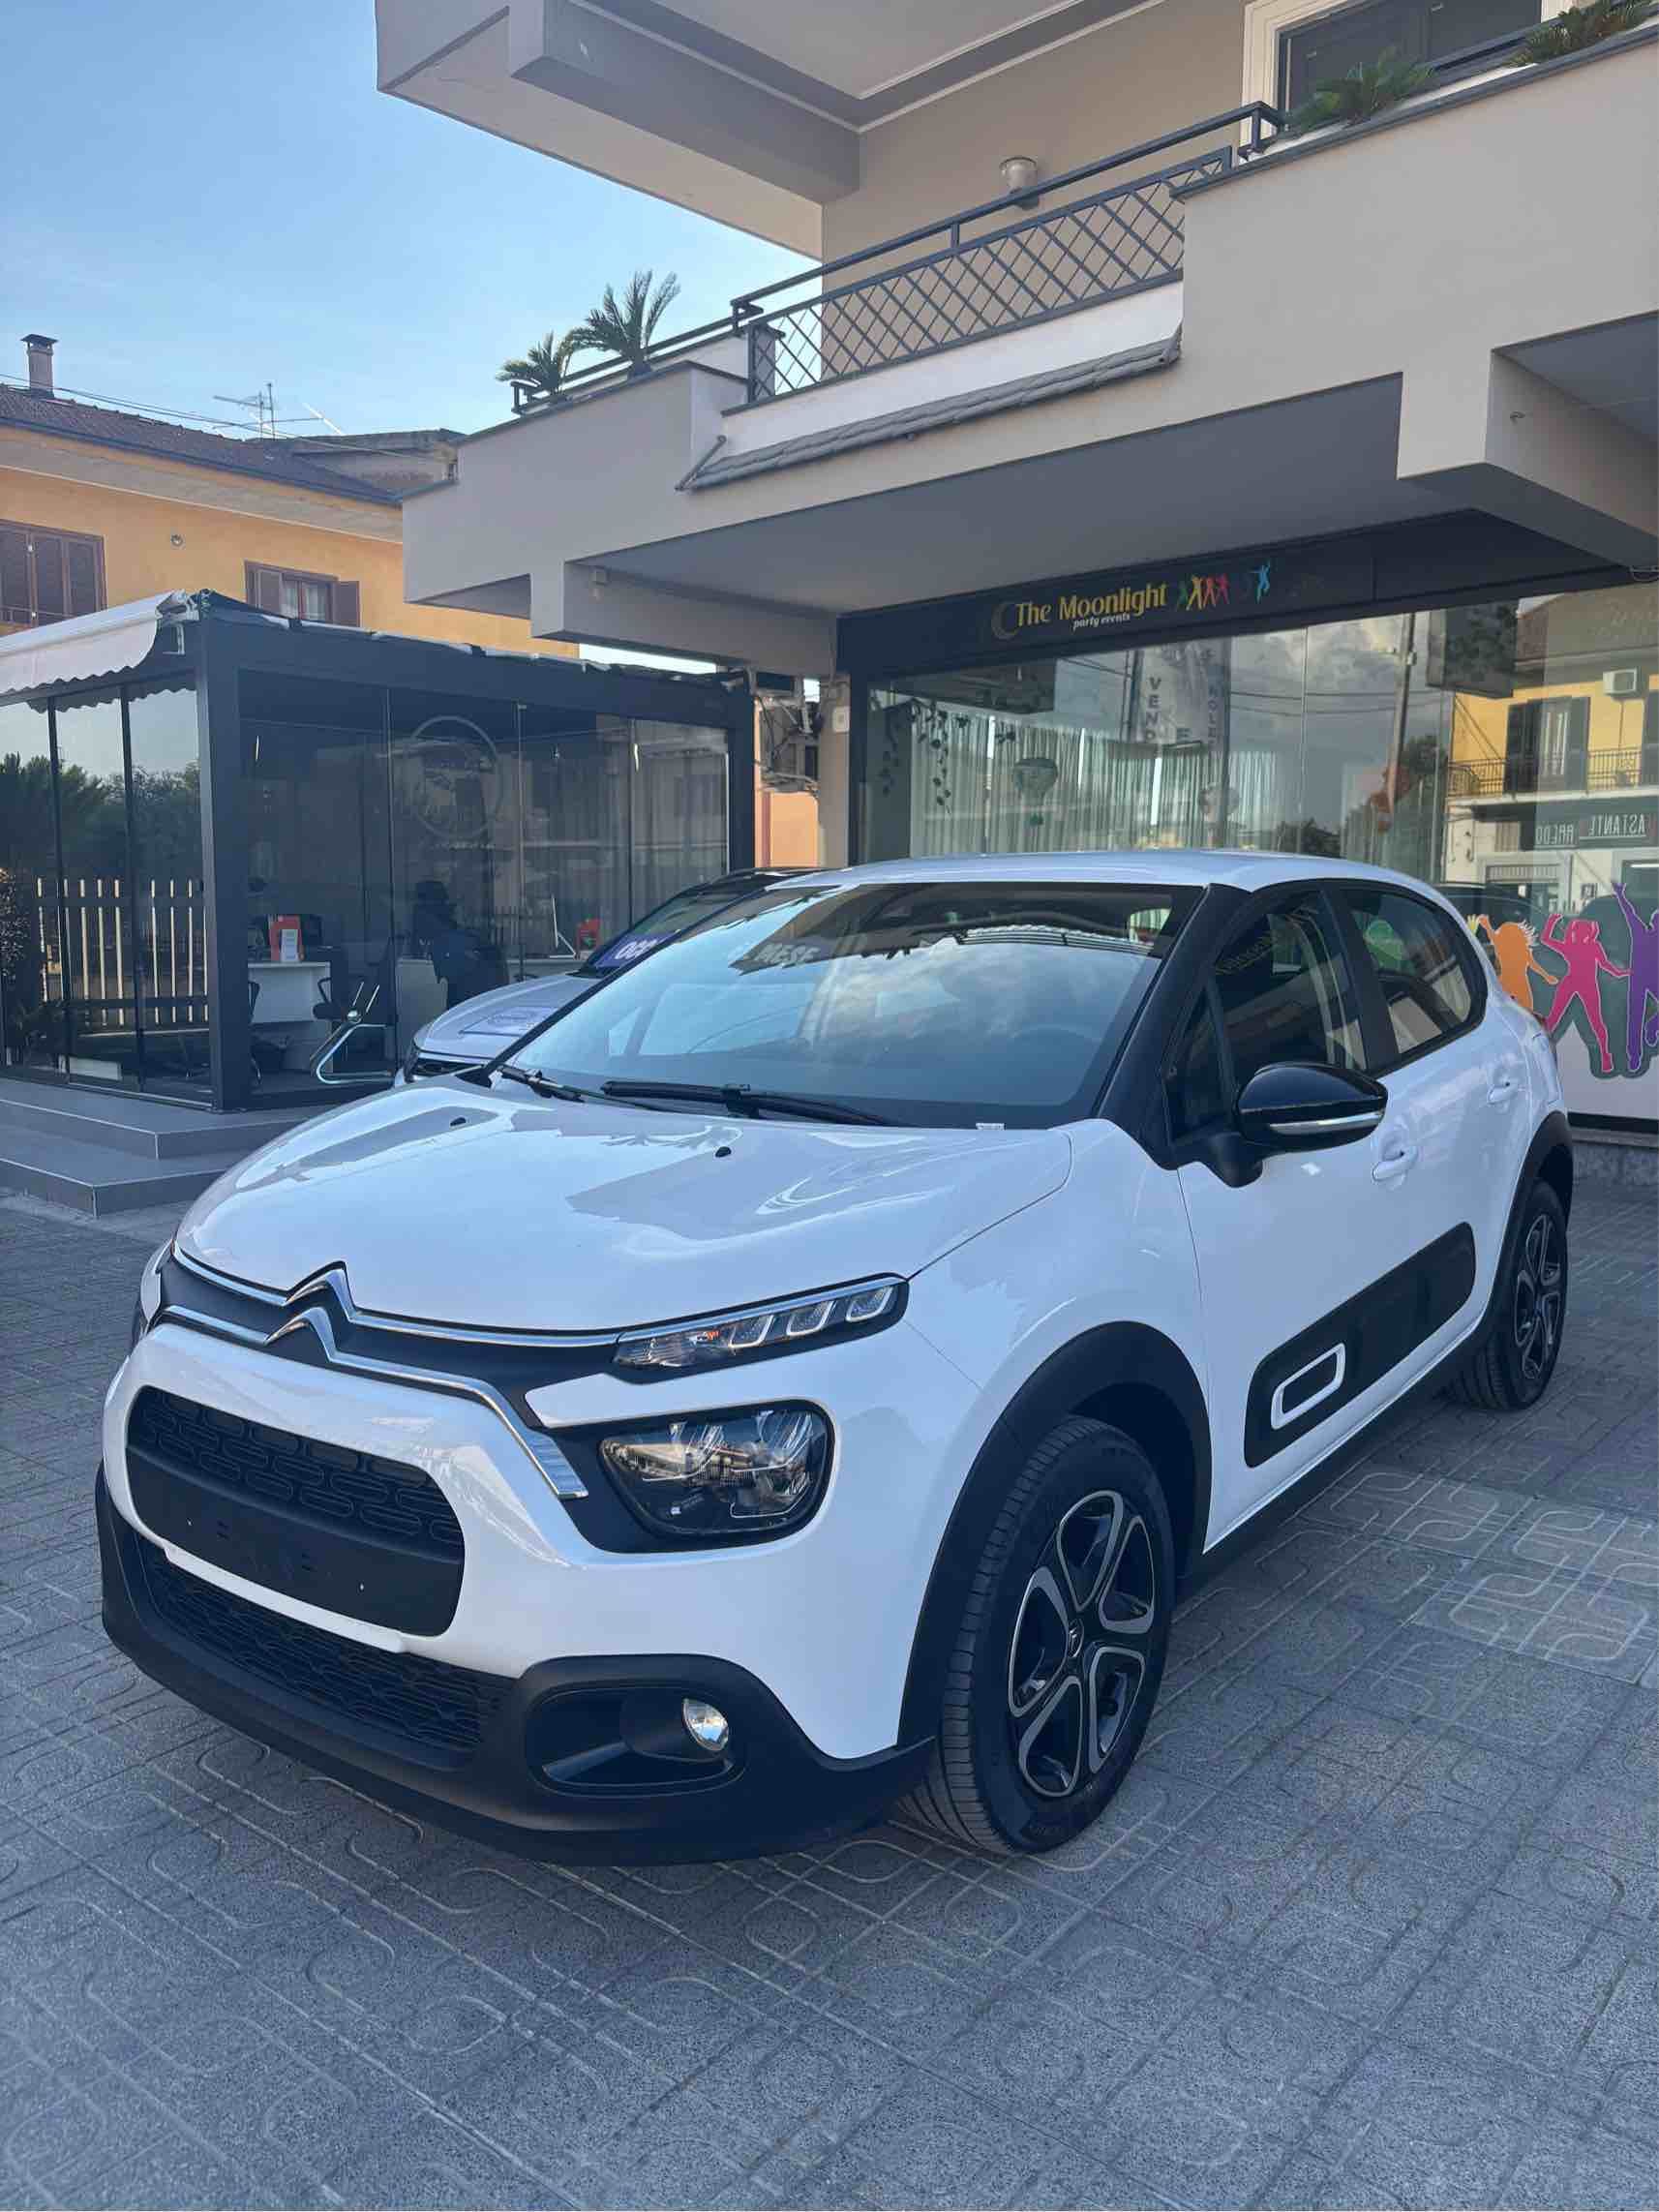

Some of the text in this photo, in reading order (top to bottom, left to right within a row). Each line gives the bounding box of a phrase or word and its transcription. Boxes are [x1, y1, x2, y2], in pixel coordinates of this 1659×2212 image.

[1015, 582, 1169, 627] The Moonlight
[1071, 614, 1131, 632] party events
